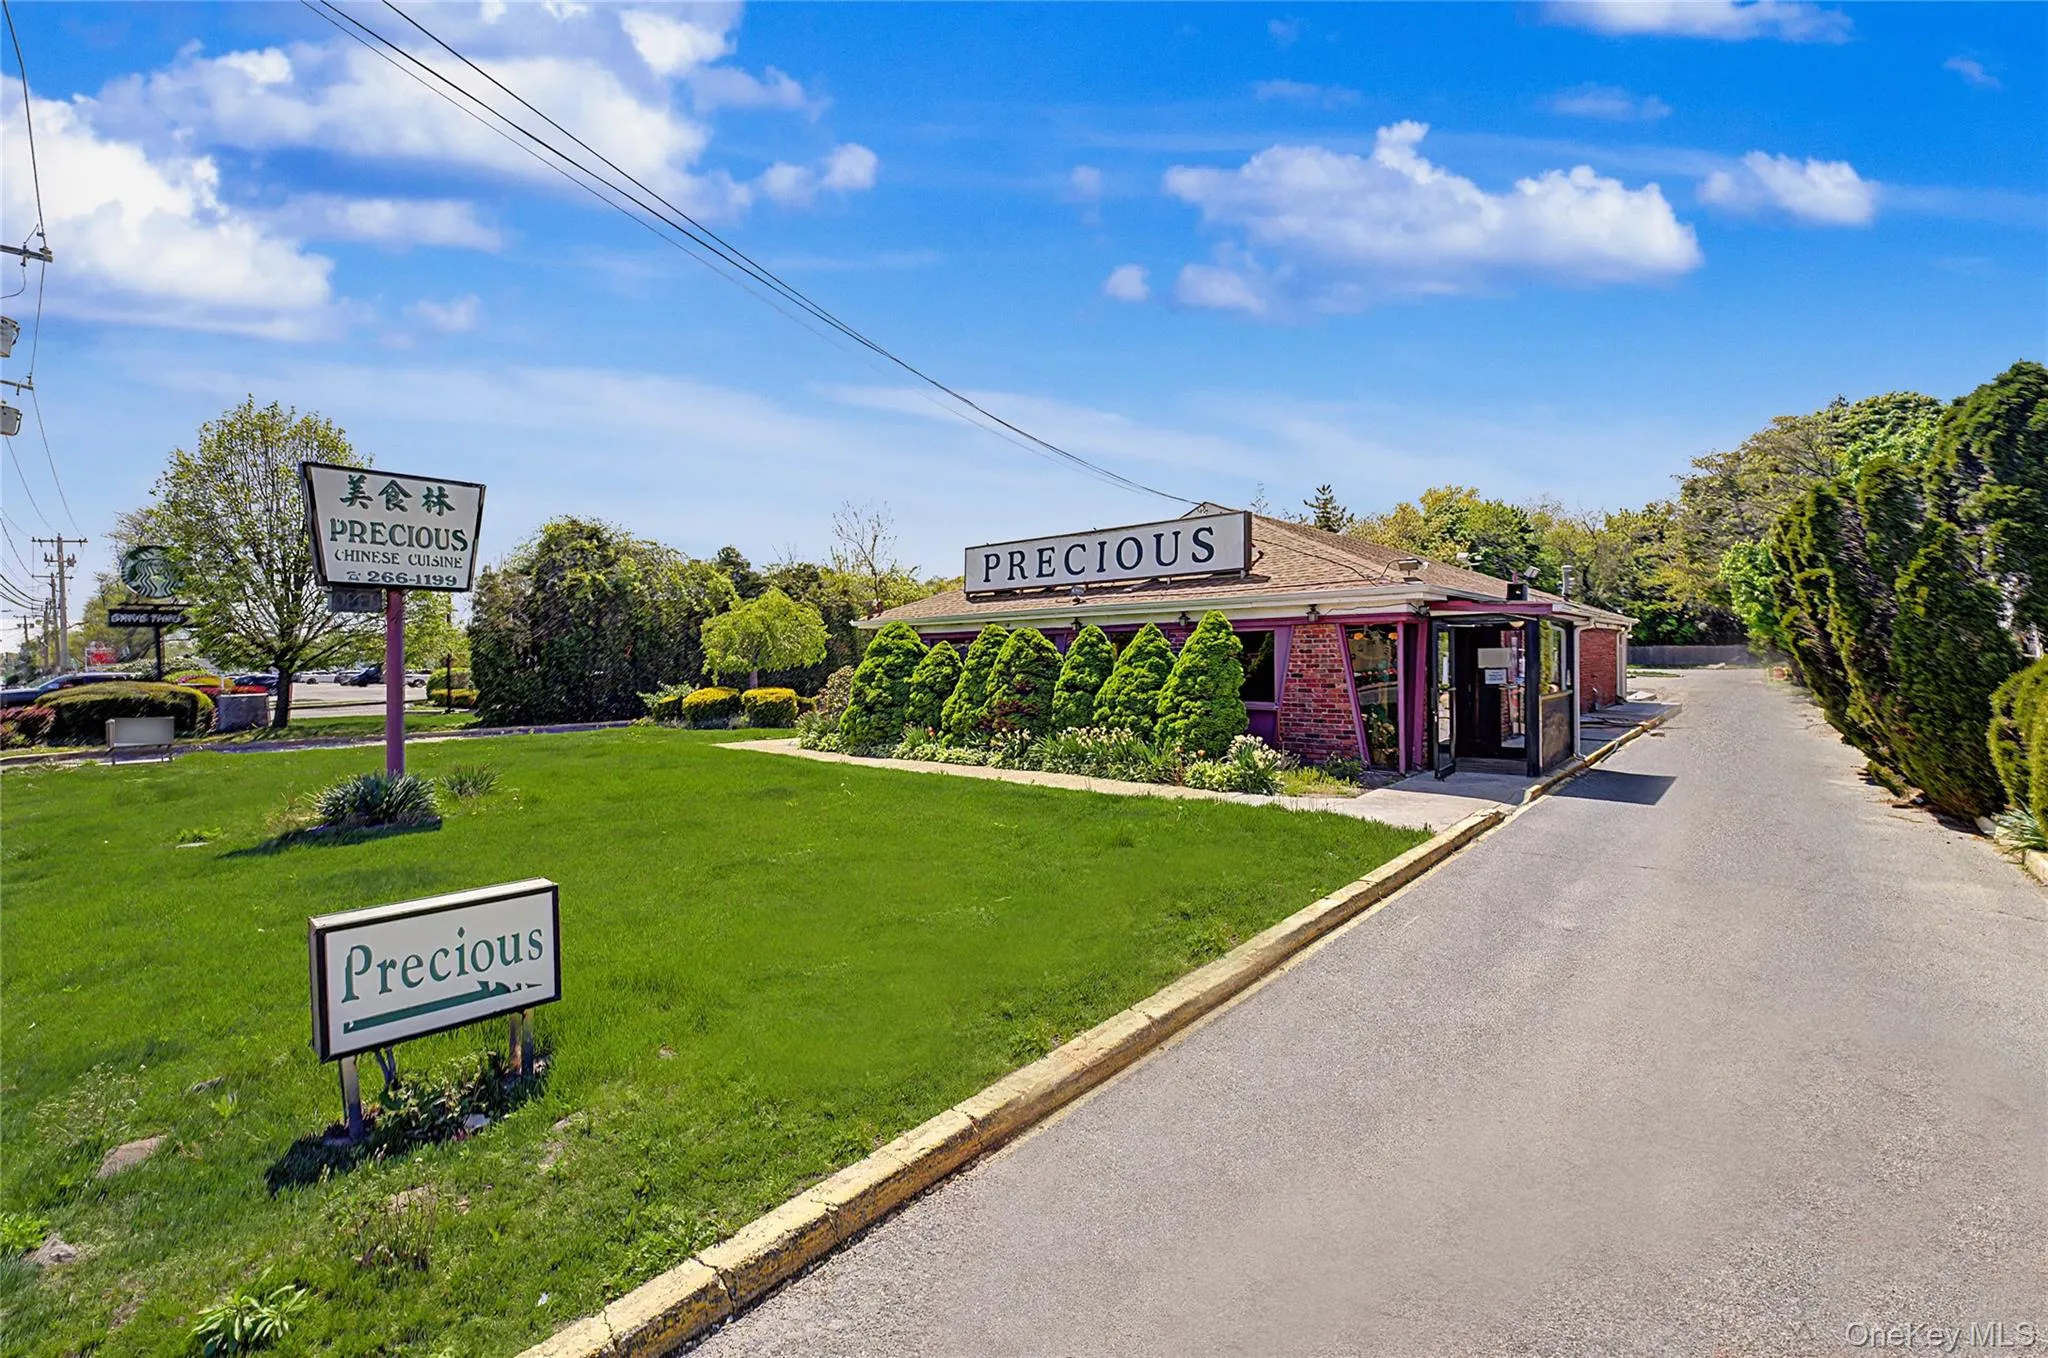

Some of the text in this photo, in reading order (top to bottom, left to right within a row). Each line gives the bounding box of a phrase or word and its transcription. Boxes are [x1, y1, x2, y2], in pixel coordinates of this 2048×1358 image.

[339, 474, 456, 517] 美食林
[329, 517, 469, 552] PRECIOUS
[334, 548, 463, 569] CHINESE CUISINE
[982, 526, 1215, 583] PRECIOUS
[367, 570, 458, 587] 266-1199
[341, 926, 544, 1004] Precious
